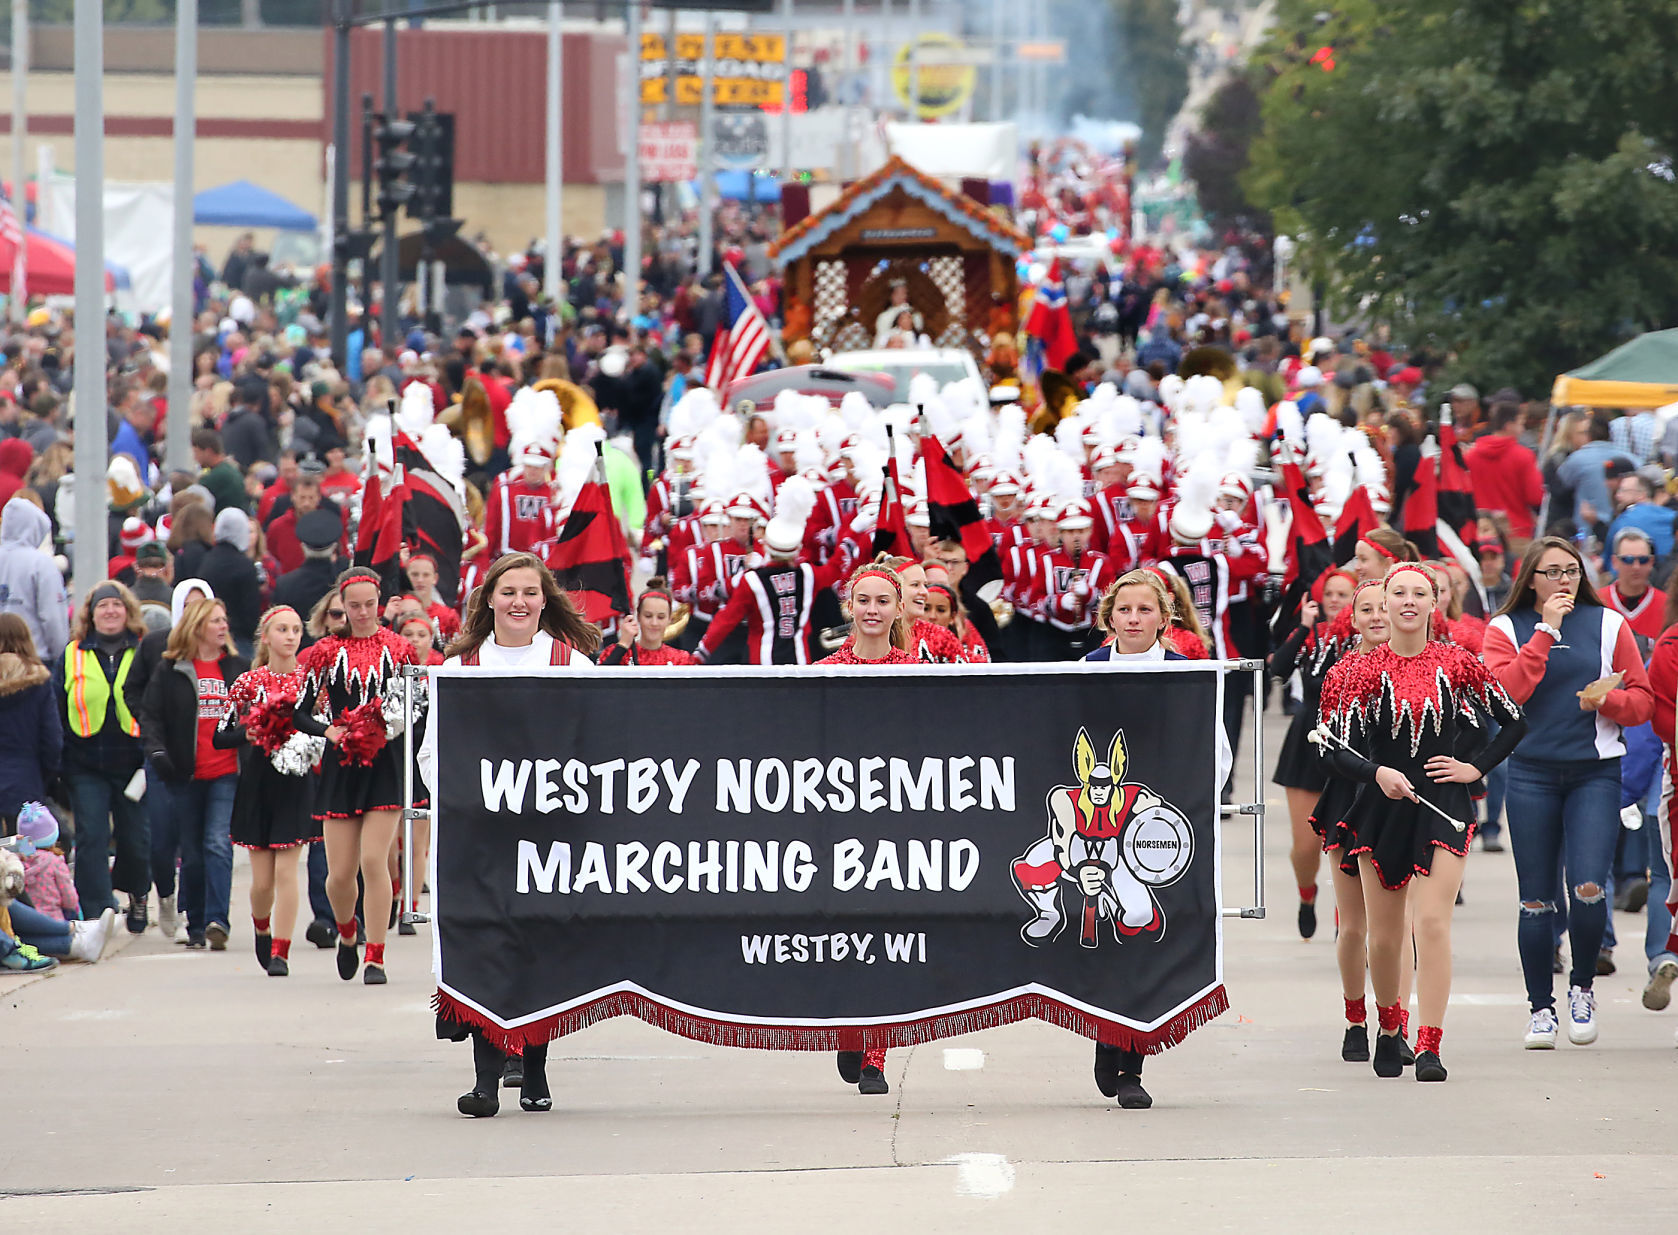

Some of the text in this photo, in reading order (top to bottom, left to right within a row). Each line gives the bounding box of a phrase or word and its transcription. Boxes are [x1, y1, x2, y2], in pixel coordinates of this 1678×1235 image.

[514, 494, 548, 521] W
[199, 678, 228, 696] STB
[480, 755, 1016, 815] WESTBY NORSEMEN
[1136, 840, 1178, 849] NORSEMEN
[515, 838, 980, 894] MARCHING BAND
[741, 932, 927, 965] WESTBY, WI
